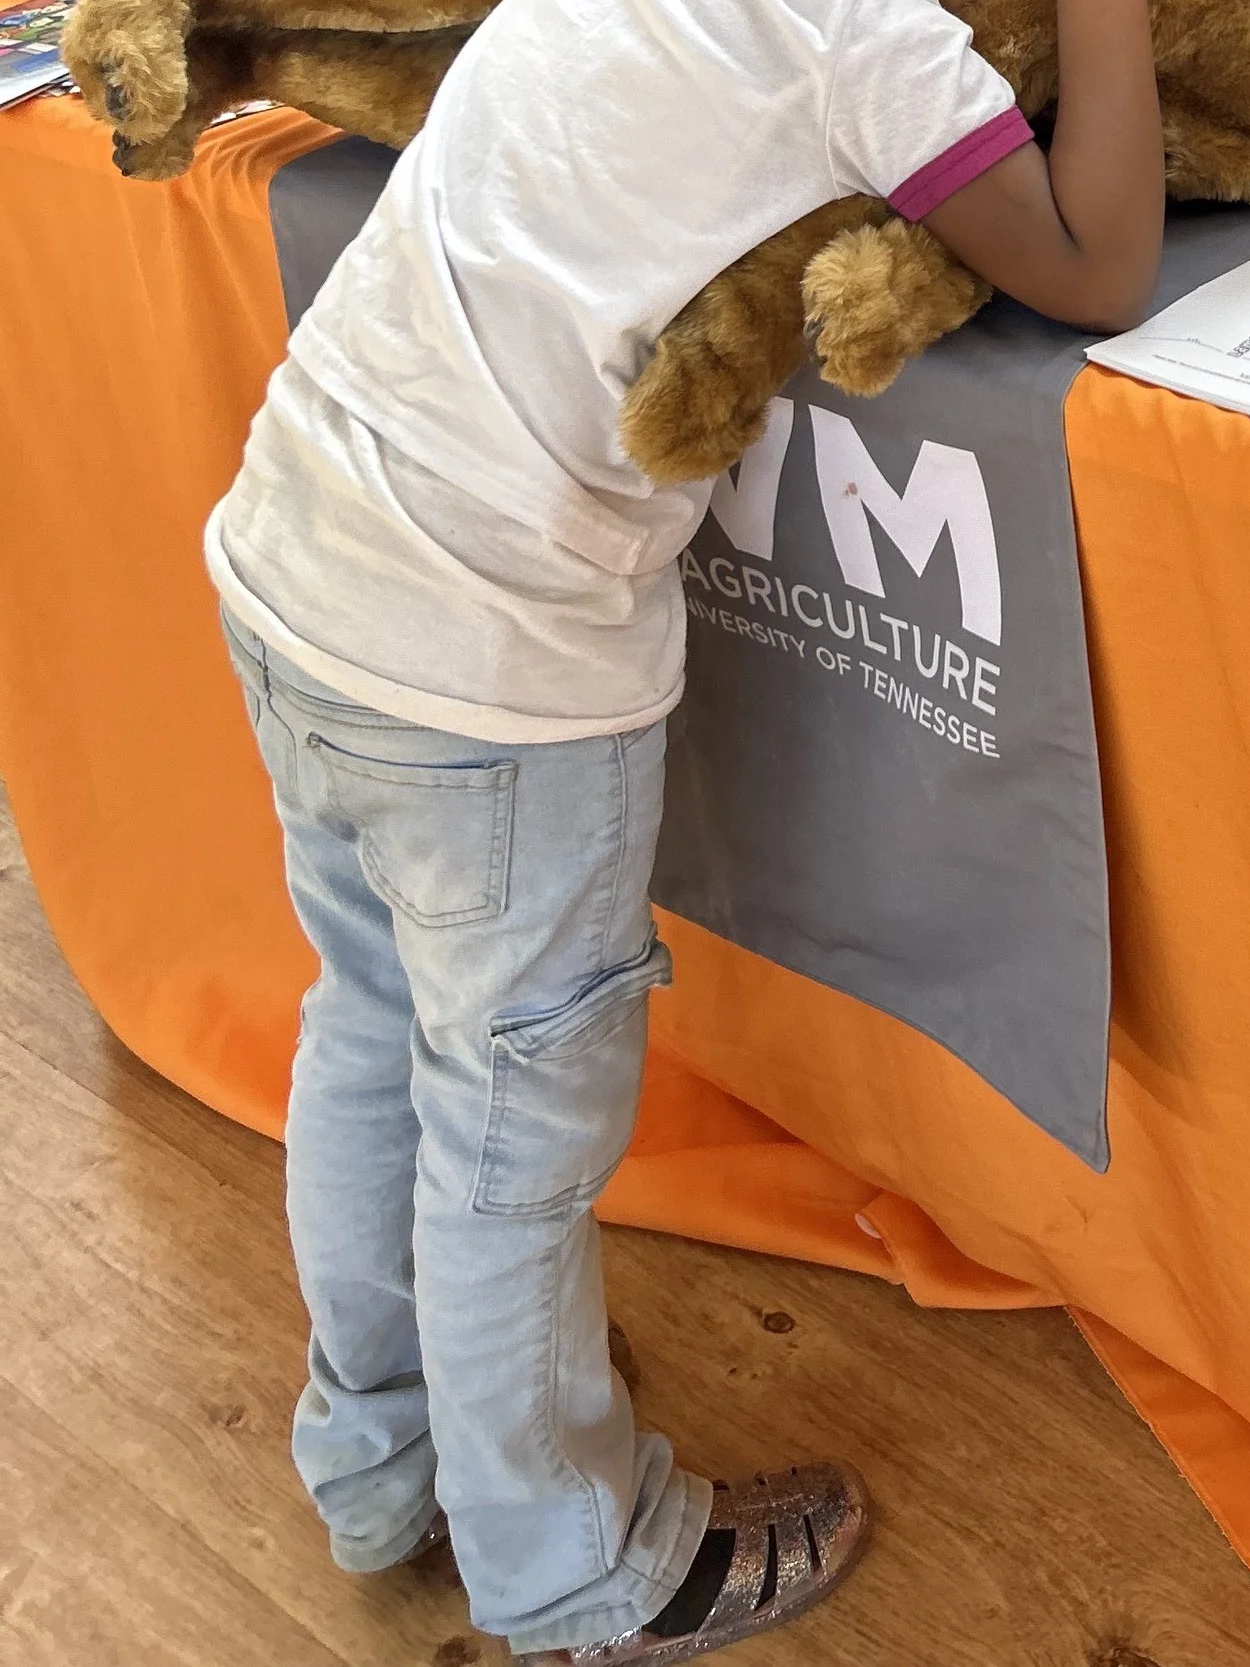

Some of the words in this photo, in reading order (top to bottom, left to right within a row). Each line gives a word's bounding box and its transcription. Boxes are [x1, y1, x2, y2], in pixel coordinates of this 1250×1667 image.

[681, 547, 1000, 716] AGRICULTURE
[686, 596, 805, 659] NIVERSITY
[815, 646, 851, 677] OF
[859, 659, 1000, 759] TENNESSEE
